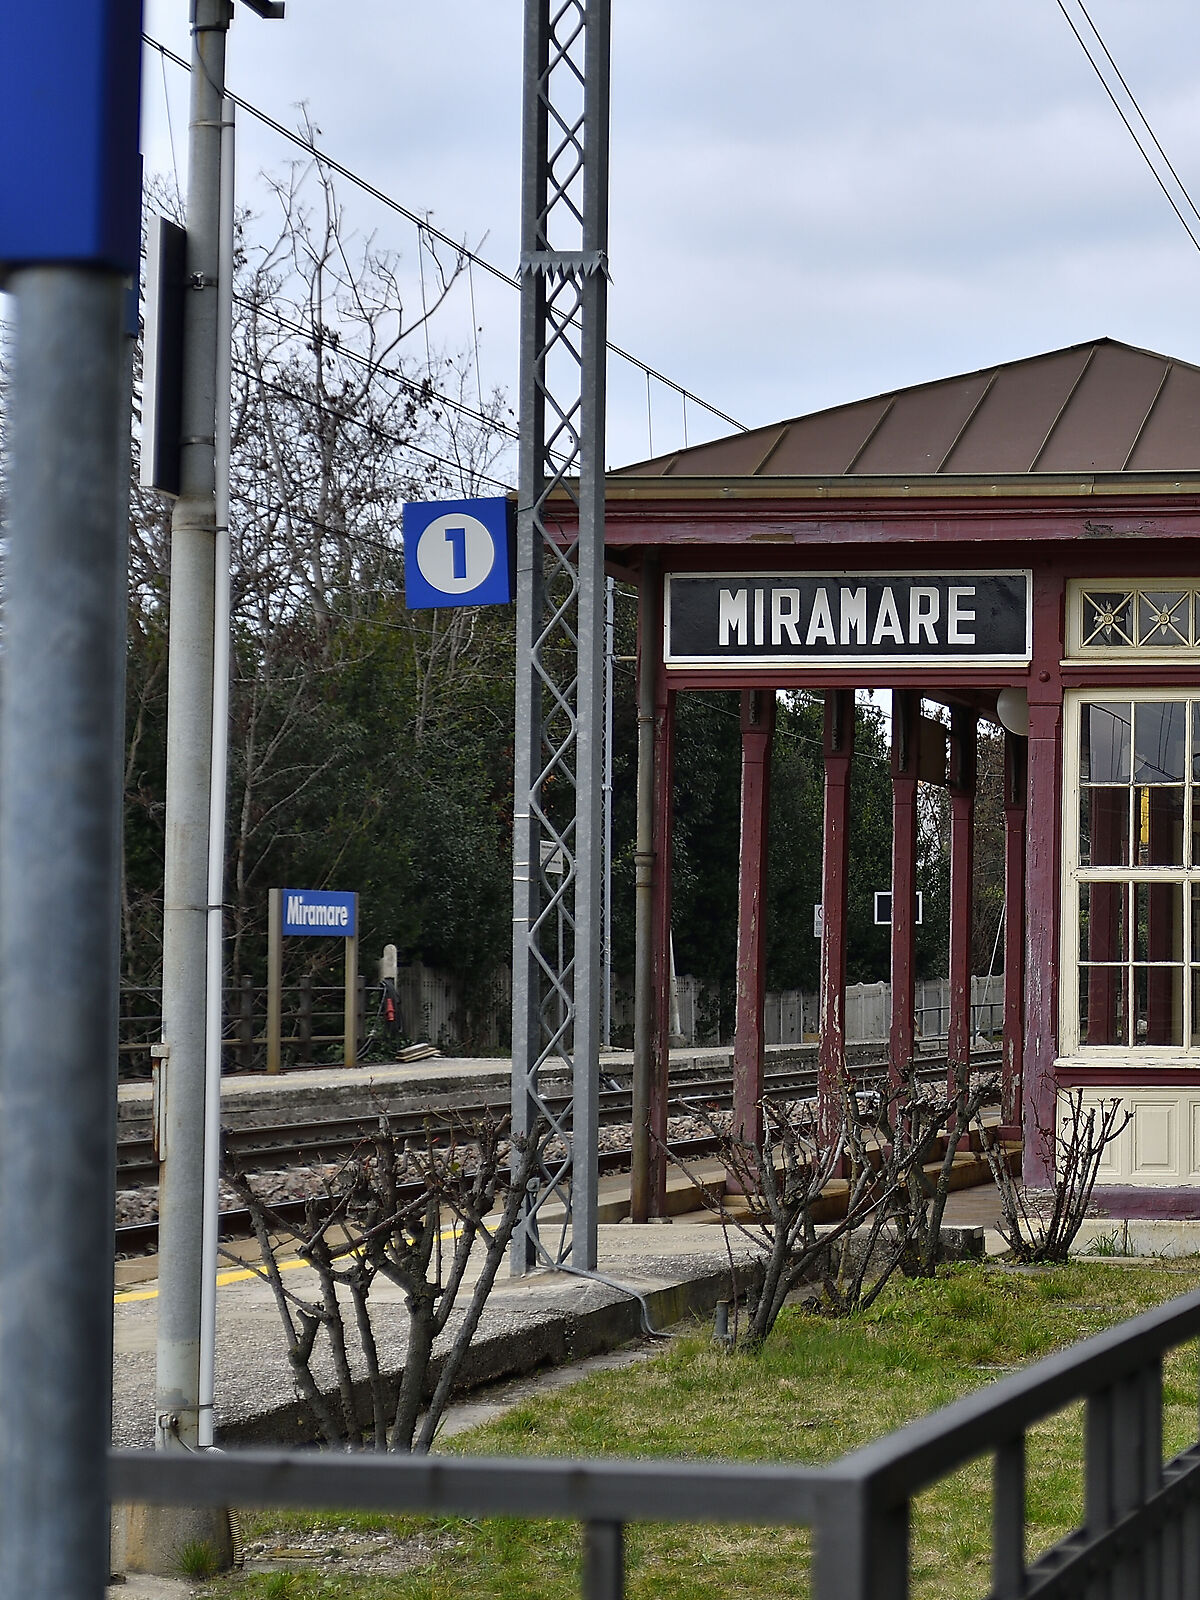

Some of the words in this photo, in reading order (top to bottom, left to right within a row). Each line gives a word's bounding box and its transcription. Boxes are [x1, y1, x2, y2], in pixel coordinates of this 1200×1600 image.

[445, 527, 467, 579] 1
[718, 586, 976, 646] MIRAMARE
[286, 895, 348, 927] Miramare
